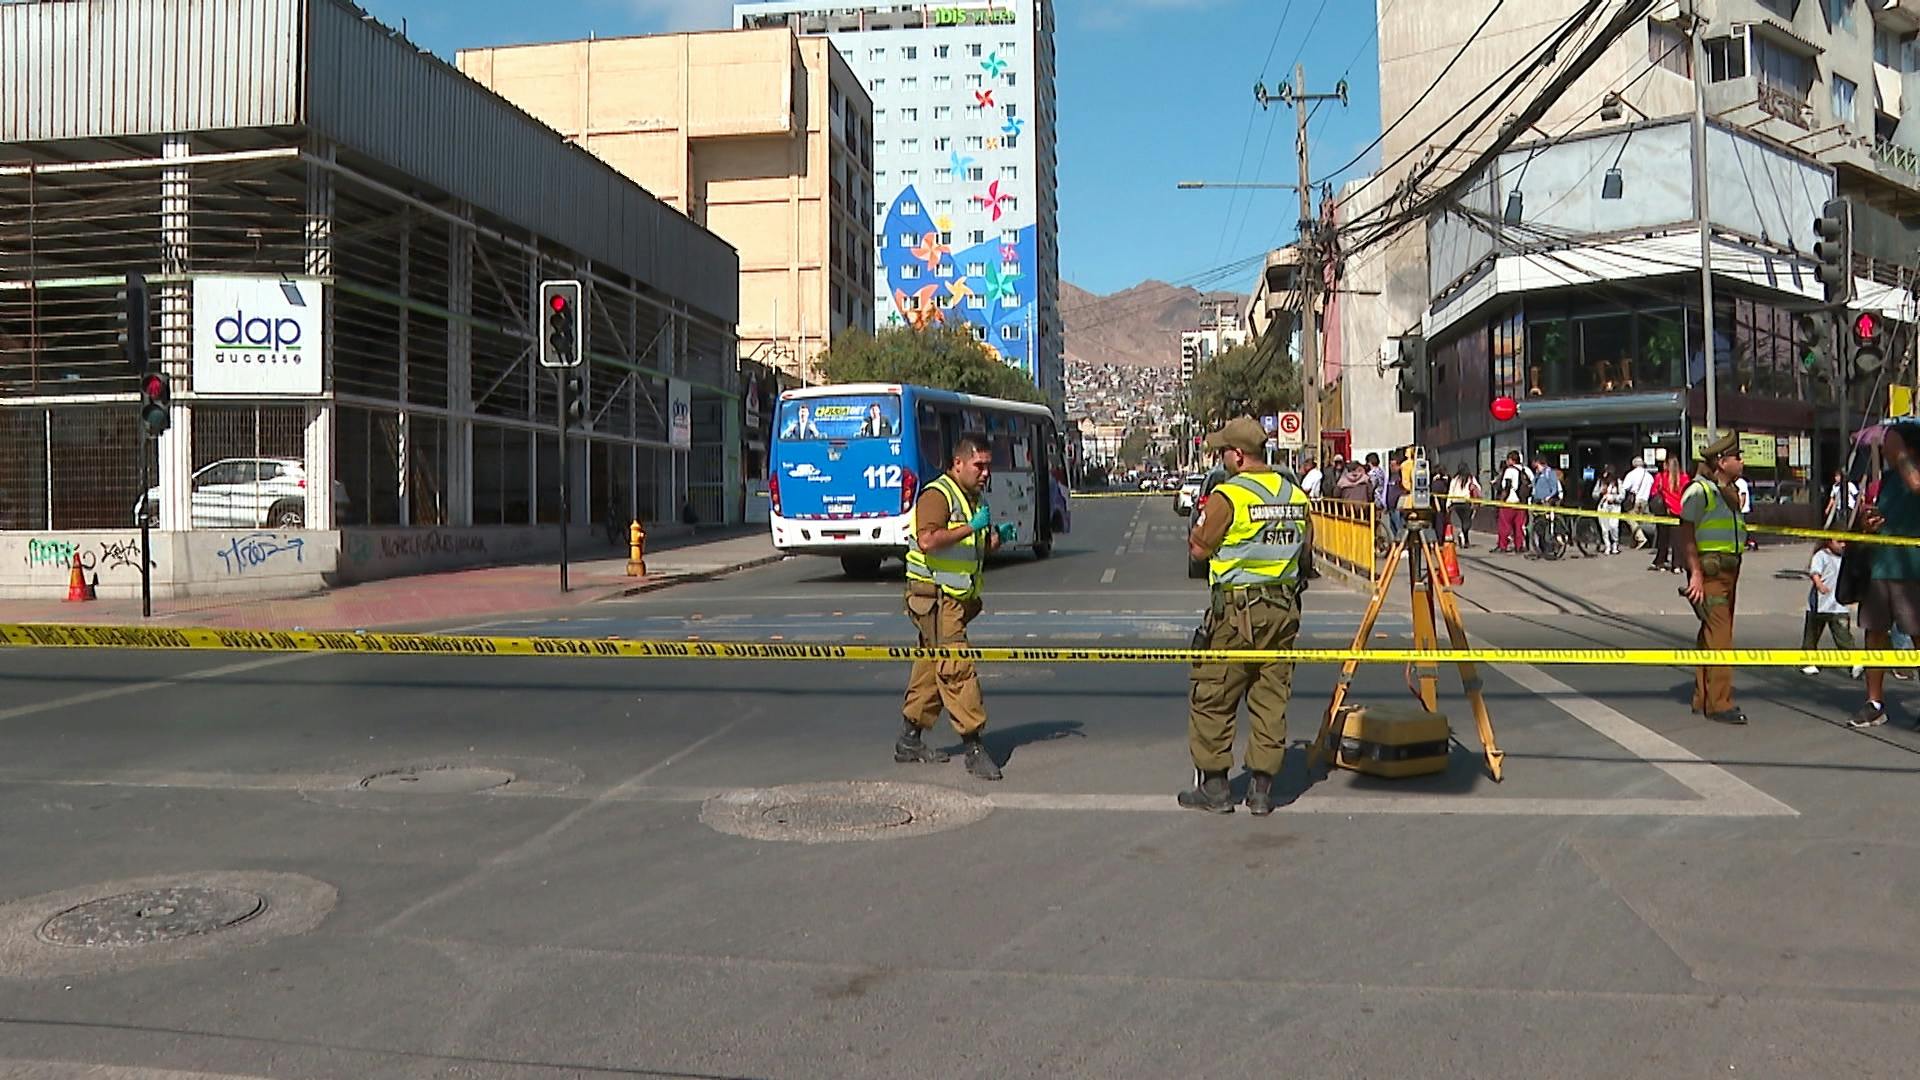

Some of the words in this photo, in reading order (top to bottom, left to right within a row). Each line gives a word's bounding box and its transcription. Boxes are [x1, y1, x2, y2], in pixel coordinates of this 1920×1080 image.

[215, 309, 301, 352] dap
[215, 352, 302, 364] ducasse
[863, 465, 902, 490] 112
[1265, 531, 1292, 545] SIAT
[595, 641, 620, 655] NO
